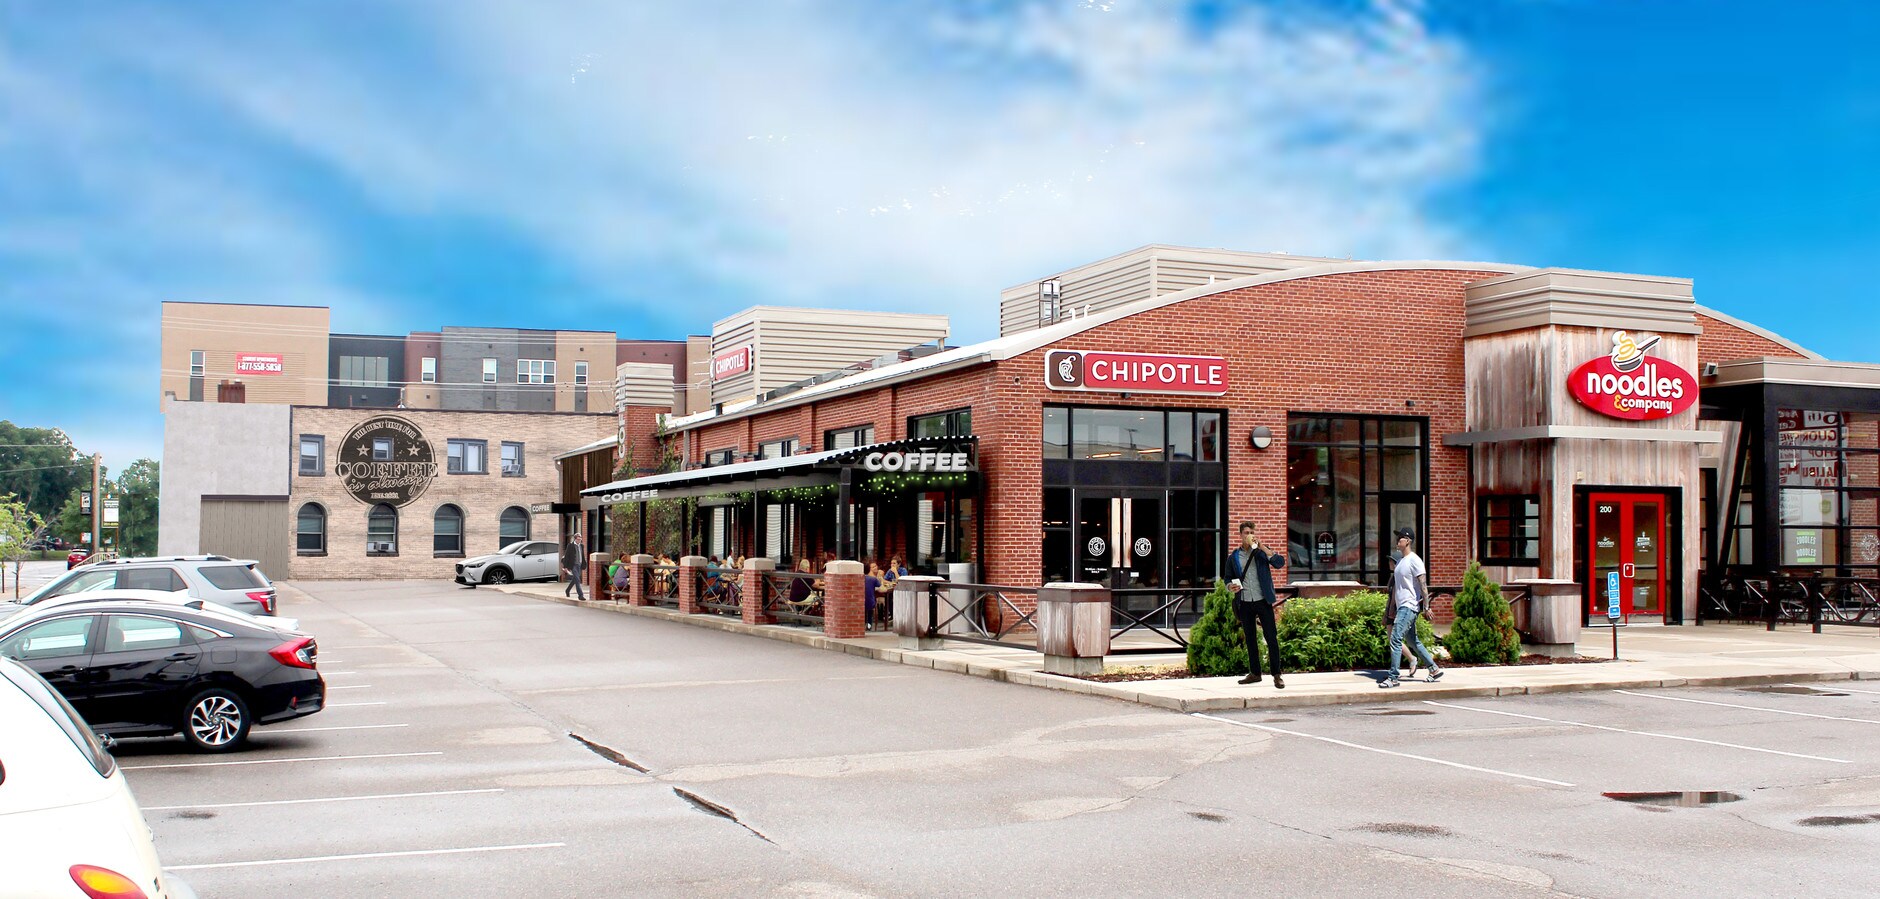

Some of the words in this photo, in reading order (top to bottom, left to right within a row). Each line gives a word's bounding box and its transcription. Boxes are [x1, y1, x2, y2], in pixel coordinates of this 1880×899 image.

[716, 353, 745, 374] CHIPOTLE
[1091, 360, 1223, 385] CHIPOTLE
[1587, 363, 1684, 399] noodles
[352, 427, 367, 441] THE
[365, 421, 384, 432] BEST
[385, 420, 403, 432] TIME
[402, 425, 417, 439] FOR
[335, 461, 439, 479] COFFEE
[864, 452, 968, 472] COFFEE
[347, 478, 365, 492] is
[367, 471, 428, 496] always
[601, 489, 658, 502] COFFEE
[532, 504, 550, 513] COFFEE
